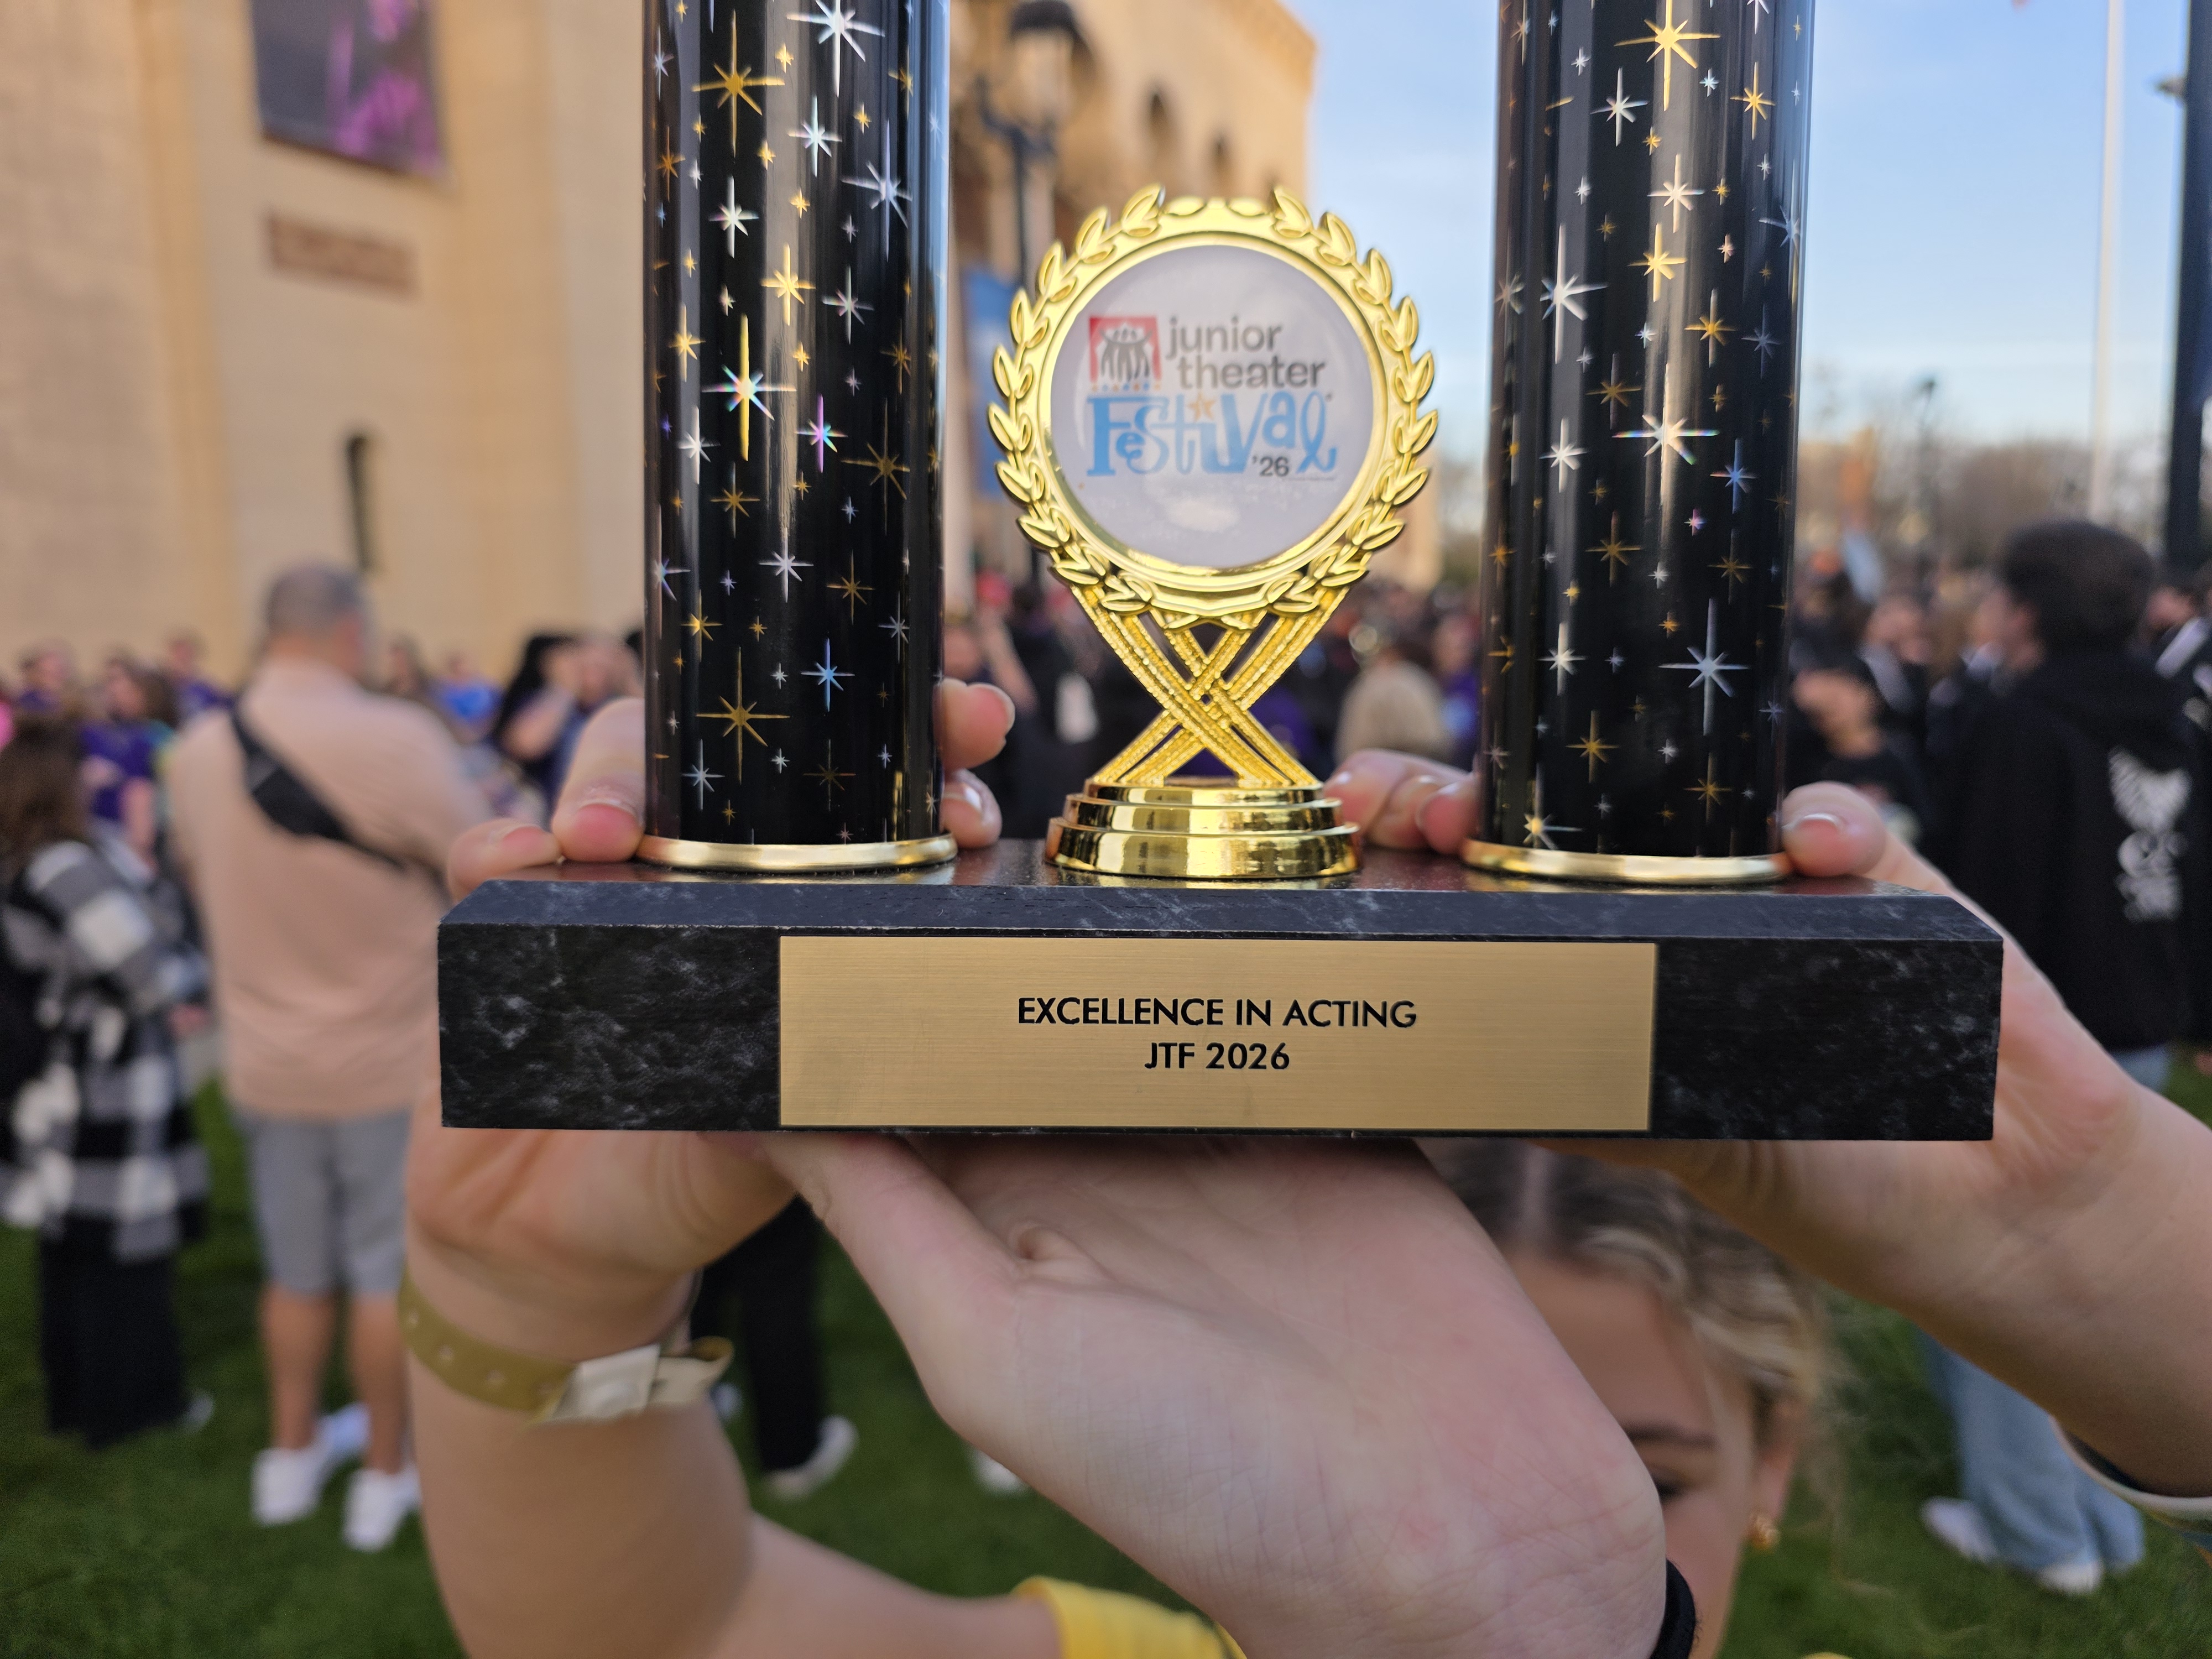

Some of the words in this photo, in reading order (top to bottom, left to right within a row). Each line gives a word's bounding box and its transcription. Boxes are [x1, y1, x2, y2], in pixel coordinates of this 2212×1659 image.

[1166, 316, 1283, 360] junior
[1177, 356, 1326, 389] theater
[1252, 455, 1290, 477] '26
[1018, 997, 1224, 1026] EXCELLENCE
[1235, 998, 1271, 1027] IN
[1281, 999, 1417, 1029] ACTING
[1144, 1042, 1196, 1070] JTF
[1205, 1042, 1290, 1071] 2026
